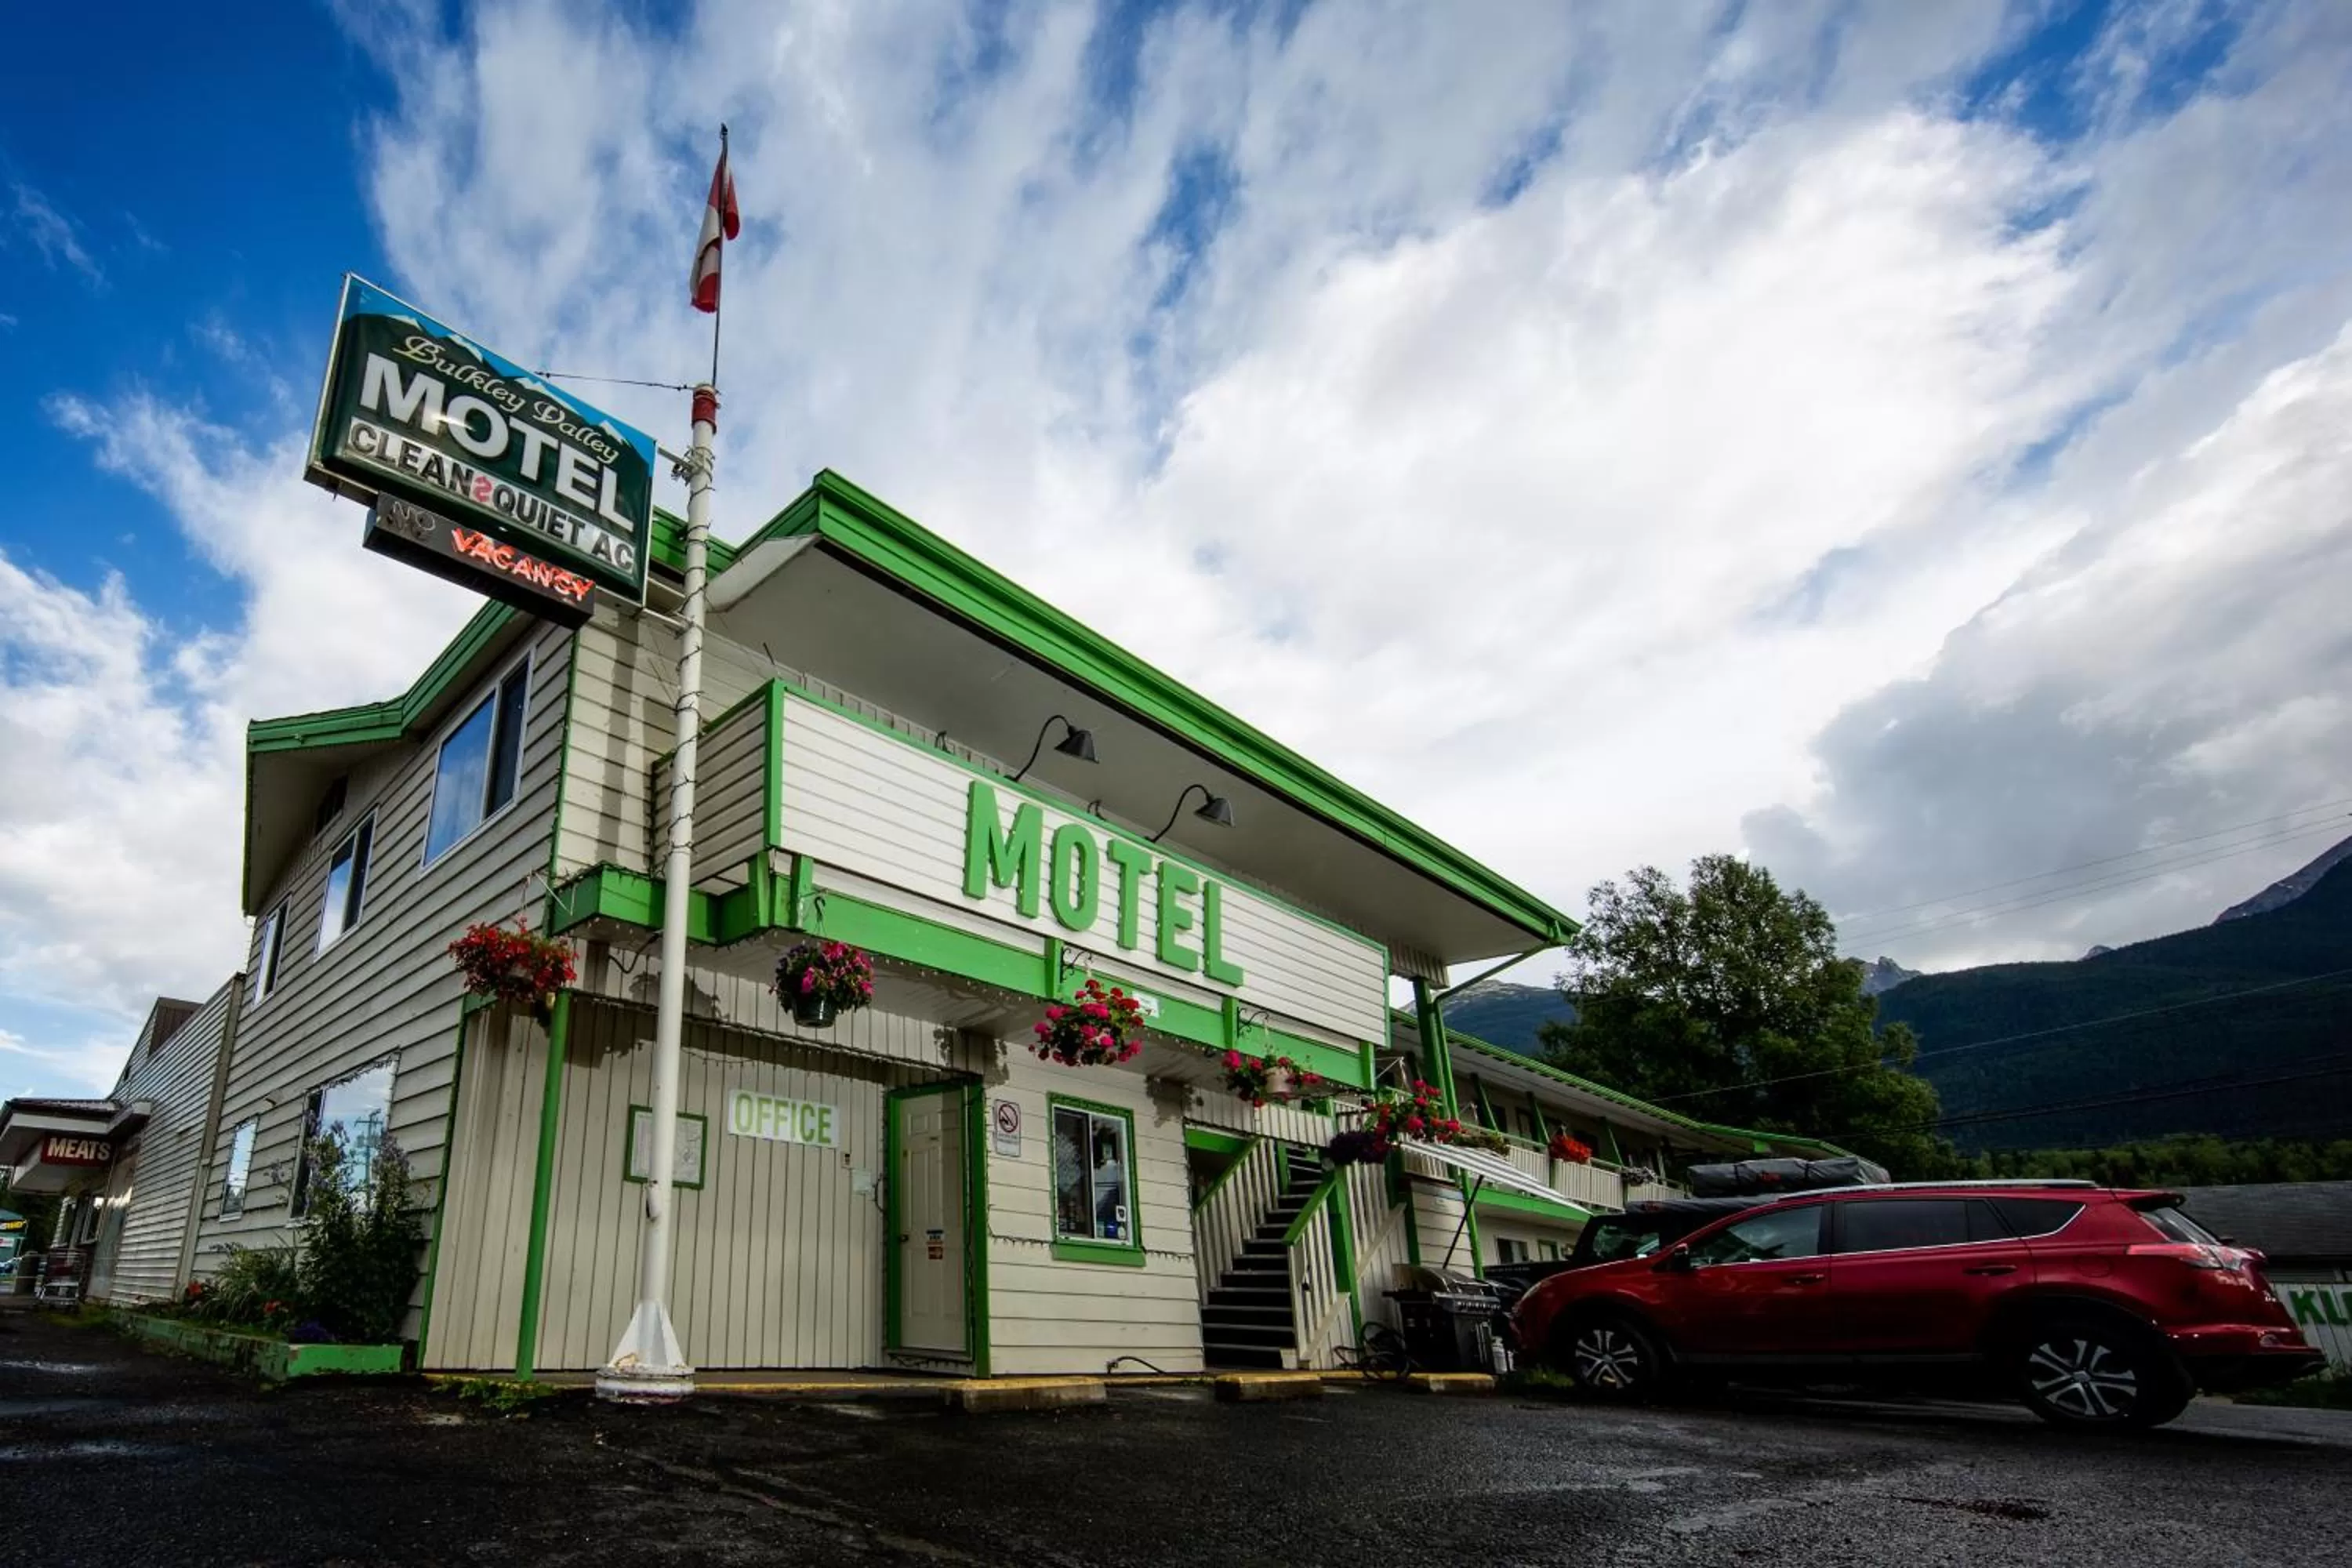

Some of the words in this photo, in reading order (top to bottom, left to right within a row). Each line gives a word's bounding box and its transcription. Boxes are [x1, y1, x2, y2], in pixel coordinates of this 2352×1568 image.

[359, 352, 634, 533] MOTEL
[392, 336, 527, 412] Bulkley
[532, 399, 619, 466] Valley
[352, 423, 474, 499] CLEAN
[492, 484, 586, 546] QUIET
[591, 532, 633, 569] AC
[452, 527, 594, 601] VACANCY
[962, 780, 1245, 988] MOTEL
[47, 1138, 111, 1160] MEATS
[735, 1093, 832, 1144] OFFICE
